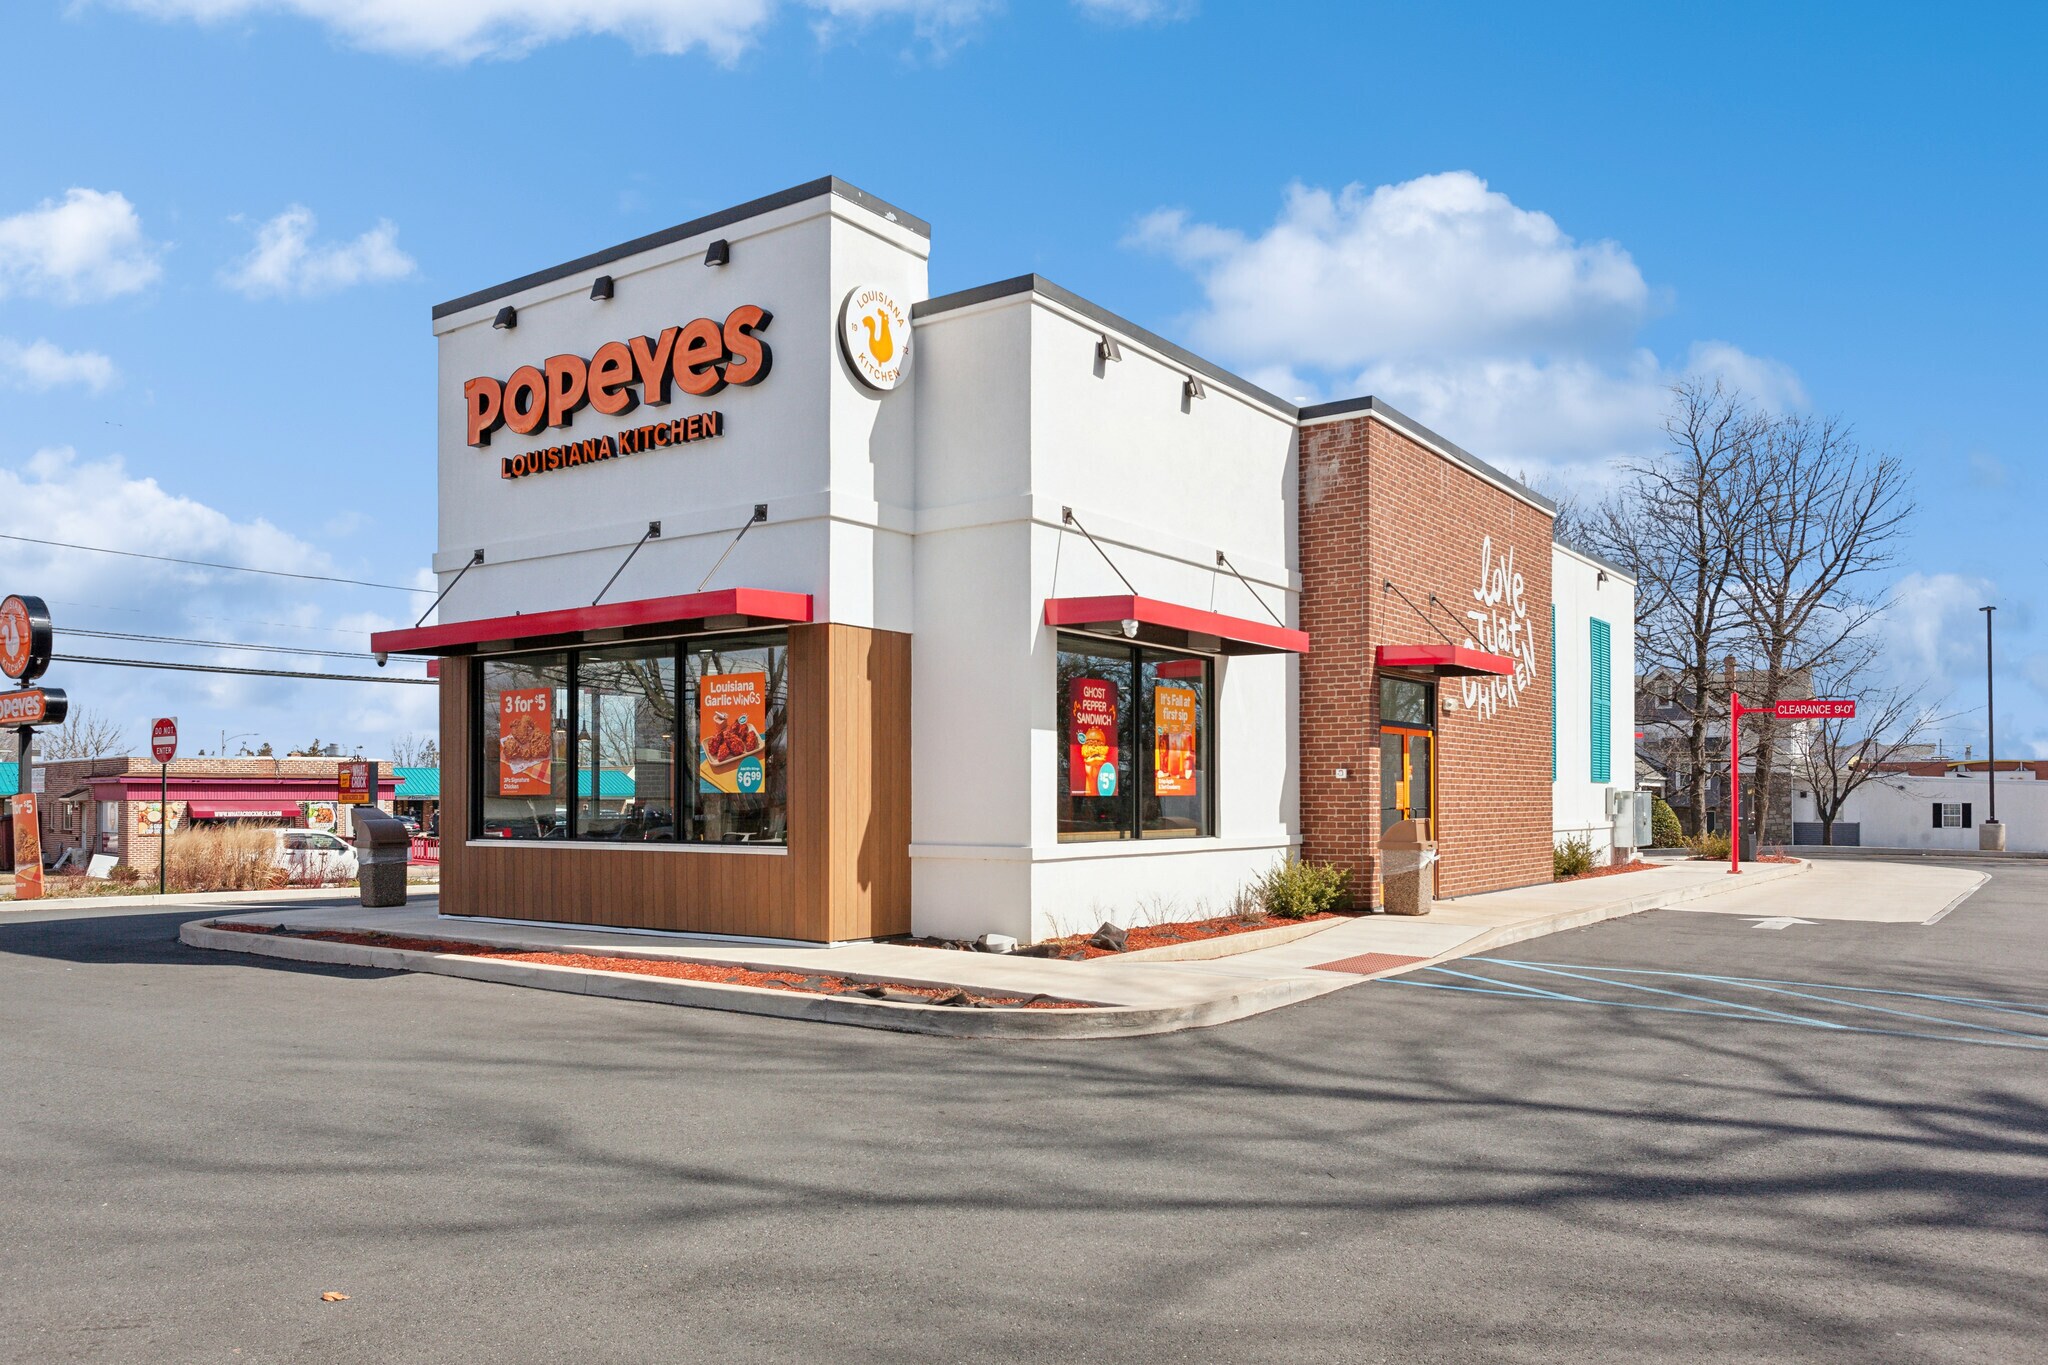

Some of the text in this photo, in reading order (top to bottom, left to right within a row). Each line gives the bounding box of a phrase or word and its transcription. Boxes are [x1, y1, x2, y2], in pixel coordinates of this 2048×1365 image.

[857, 290, 905, 328] LOUISIANA
[851, 322, 859, 332] 19
[858, 352, 901, 382] KITCHEN
[501, 411, 723, 480] LOUISIANA KITCHEN
[2, 654, 26, 673] KITCHEN
[710, 680, 755, 693] Louisiana
[1083, 686, 1106, 699] GHOST
[505, 694, 546, 713] 3 for $5
[705, 694, 732, 707] Garlic
[1082, 700, 1107, 712] PEPPER
[1160, 693, 1191, 708] It's Fall at
[1163, 707, 1188, 723] first sip
[1777, 704, 1831, 714] CLEARANCE
[1077, 712, 1112, 726] SANDWICH
[155, 726, 174, 735] DO NOT
[156, 747, 172, 755] ENTER
[352, 764, 366, 777] WHAT
[351, 776, 367, 789] CROCK
